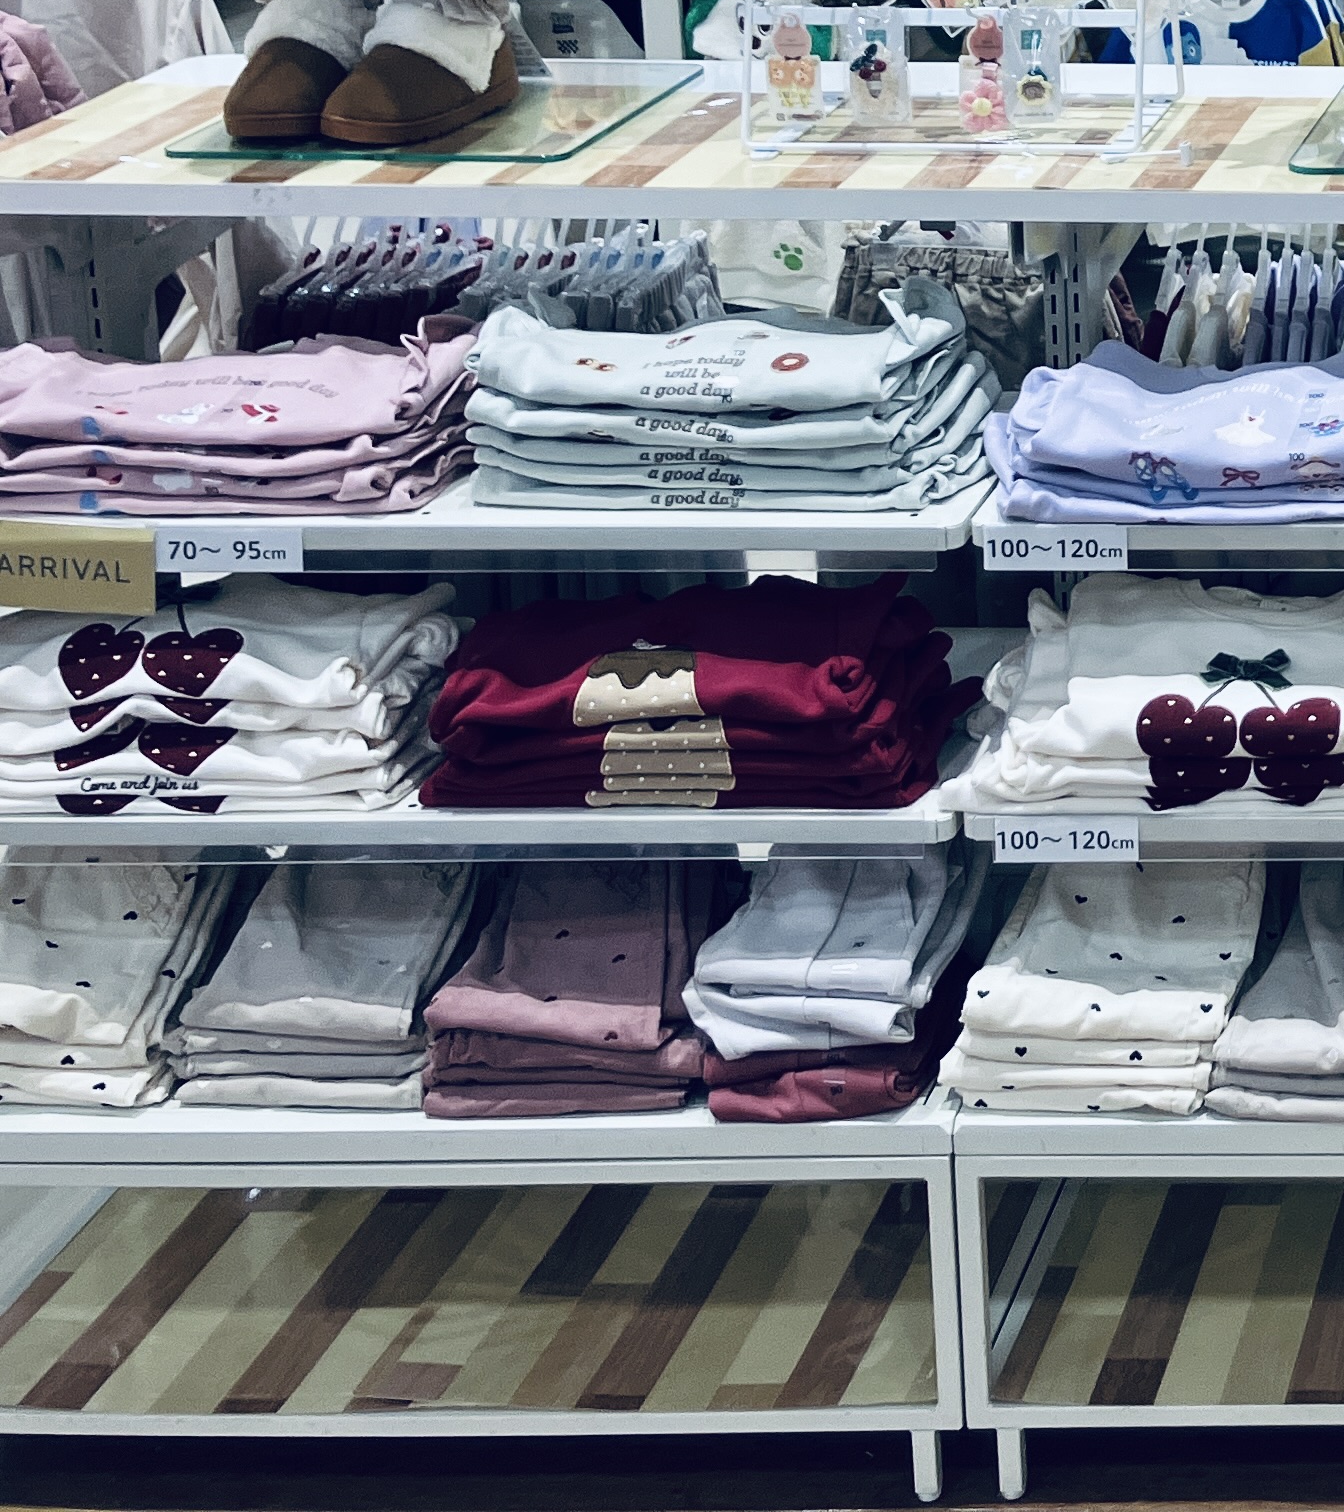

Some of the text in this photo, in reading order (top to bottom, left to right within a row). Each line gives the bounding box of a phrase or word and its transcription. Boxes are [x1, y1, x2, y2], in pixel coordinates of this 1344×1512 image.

[697, 355, 746, 367] today
[665, 368, 721, 378] will be
[640, 383, 733, 398] a good day
[636, 416, 647, 427] a
[649, 419, 695, 432] good
[639, 451, 650, 461] a
[654, 448, 695, 463] good
[1288, 452, 1306, 462] 100
[648, 468, 659, 479] a
[662, 467, 706, 482] good
[651, 491, 740, 508] a good day
[233, 540, 287, 560] 95cm
[0, 553, 131, 584] ARRIVAL
[80, 777, 117, 792] Come
[120, 775, 151, 790] and
[181, 780, 199, 790] us
